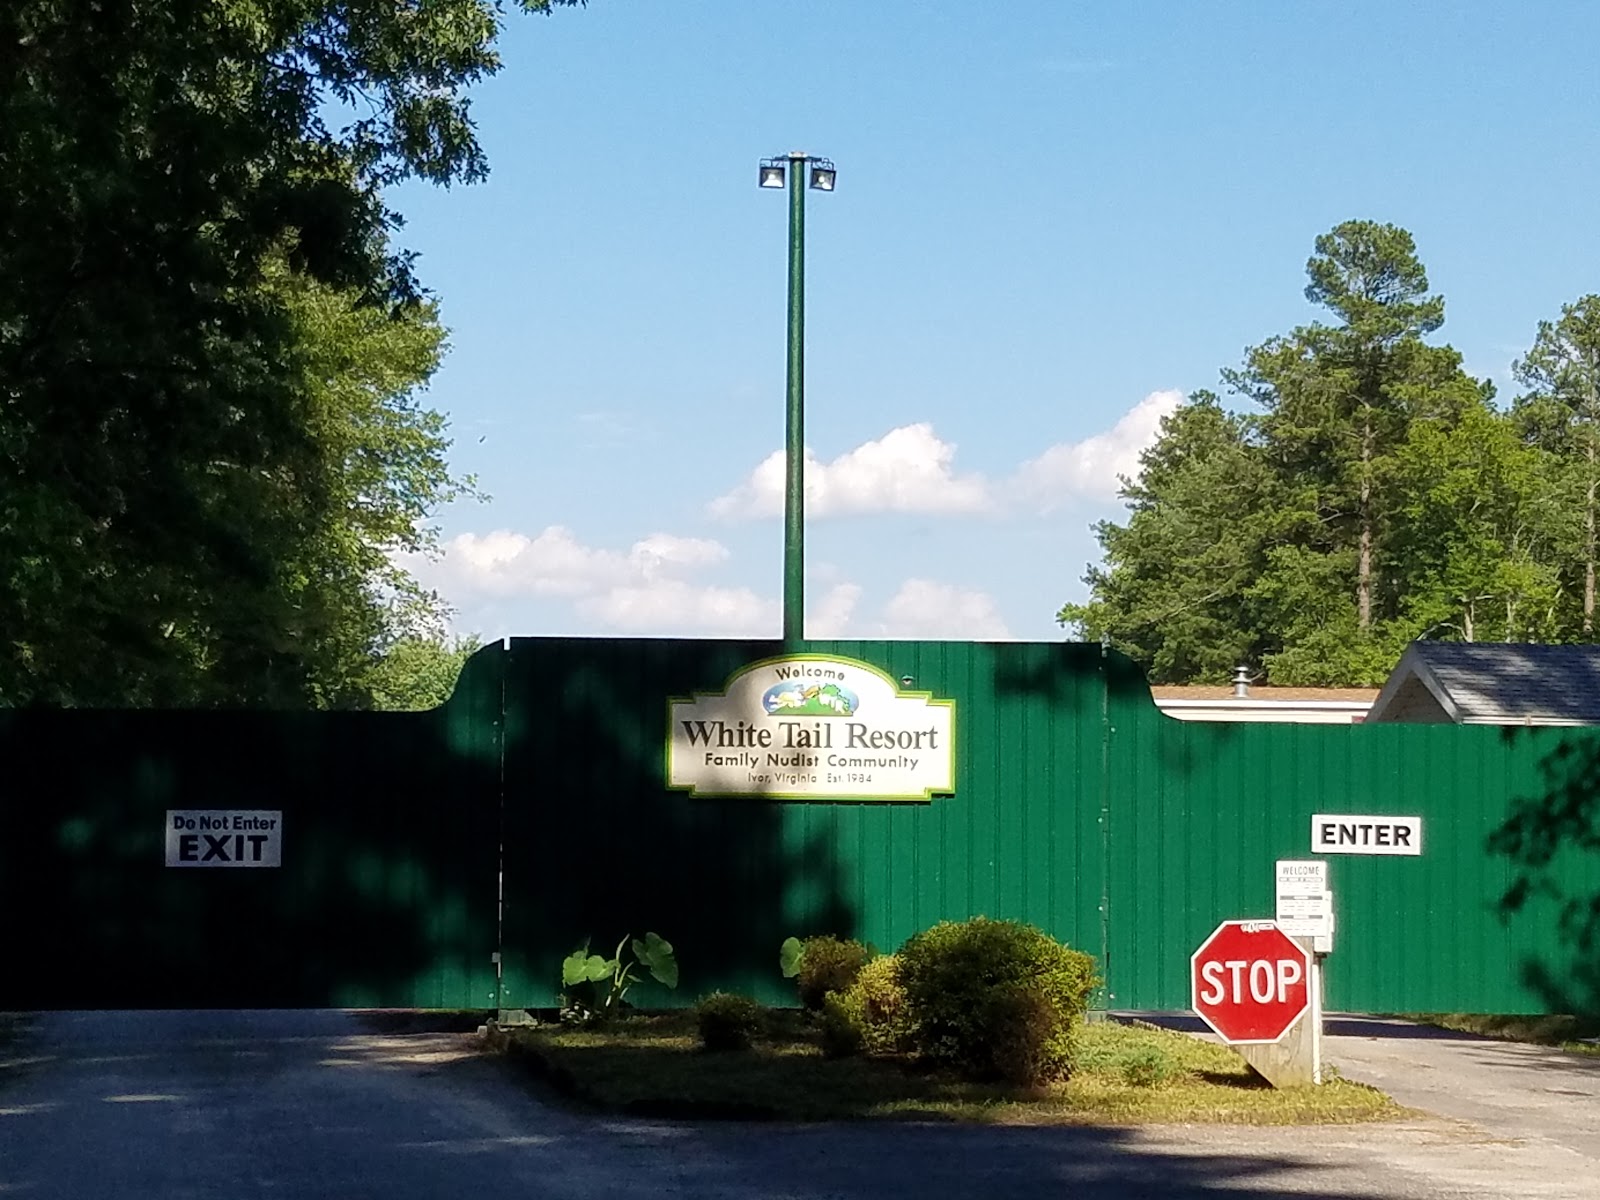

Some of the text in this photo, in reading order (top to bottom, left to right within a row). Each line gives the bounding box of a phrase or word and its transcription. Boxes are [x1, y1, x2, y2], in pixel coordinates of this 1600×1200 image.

[775, 664, 845, 681] Welcome
[681, 720, 938, 750] White Tail Resort
[704, 752, 919, 771] Family Nudist Community
[774, 773, 817, 785] Virginia
[827, 773, 844, 784] Est.
[847, 773, 872, 784] 1984
[173, 816, 276, 830] Do Not Enter
[1321, 823, 1411, 847] ENTER
[179, 834, 268, 862] EXIT
[1282, 866, 1320, 875] WELCOME
[1200, 959, 1301, 1006] STOP
